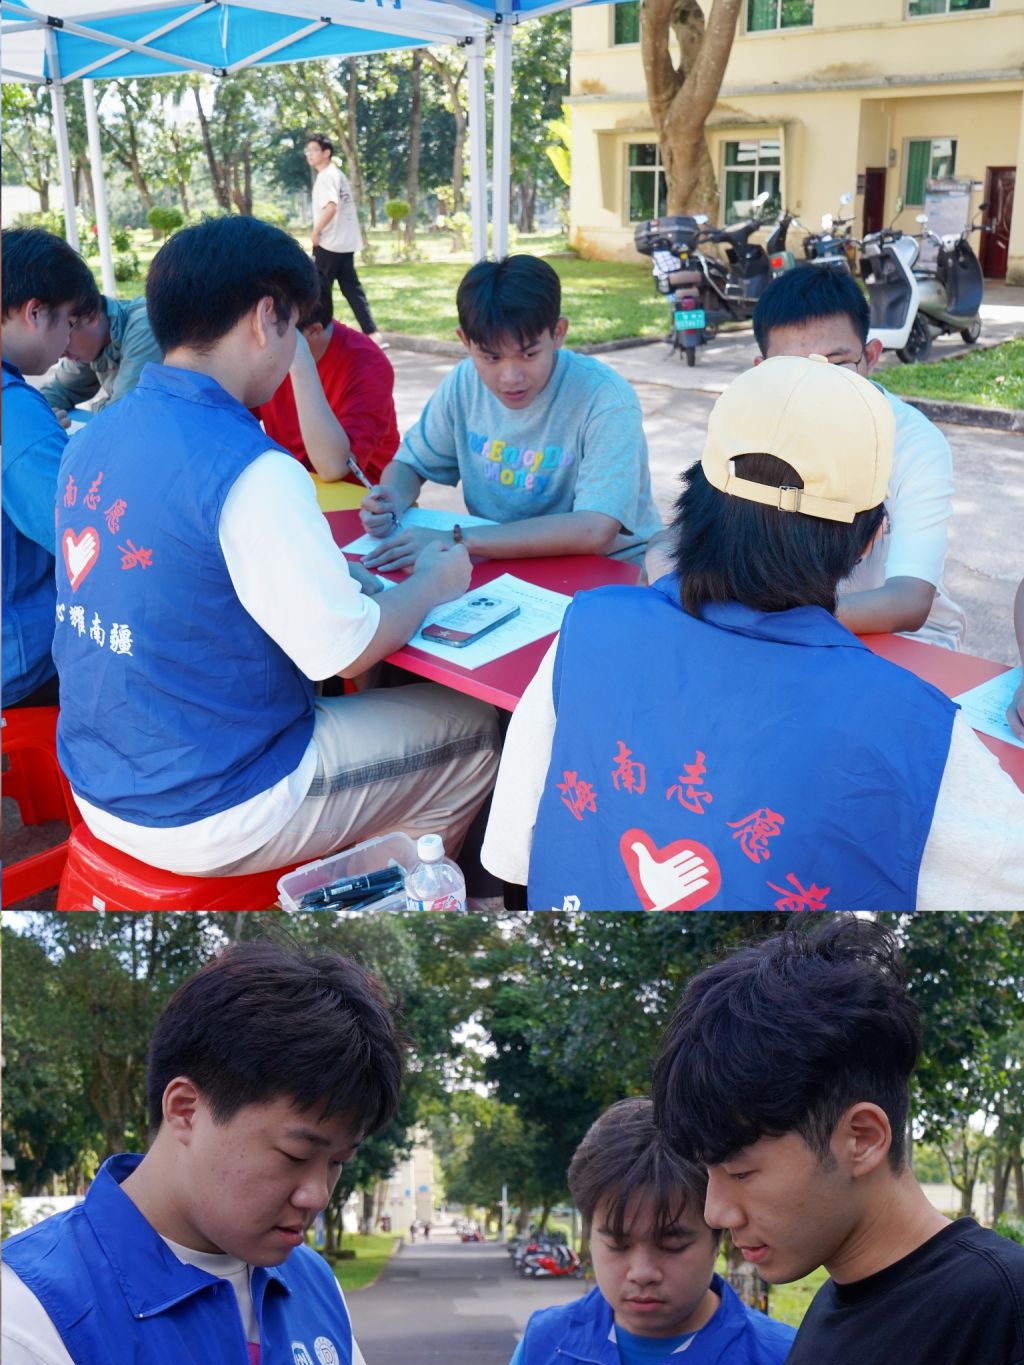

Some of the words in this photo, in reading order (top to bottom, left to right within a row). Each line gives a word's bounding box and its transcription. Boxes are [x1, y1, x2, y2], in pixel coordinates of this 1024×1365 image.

[55, 472, 153, 570] 南志愿者
[556, 740, 830, 911] 海南志愿者
